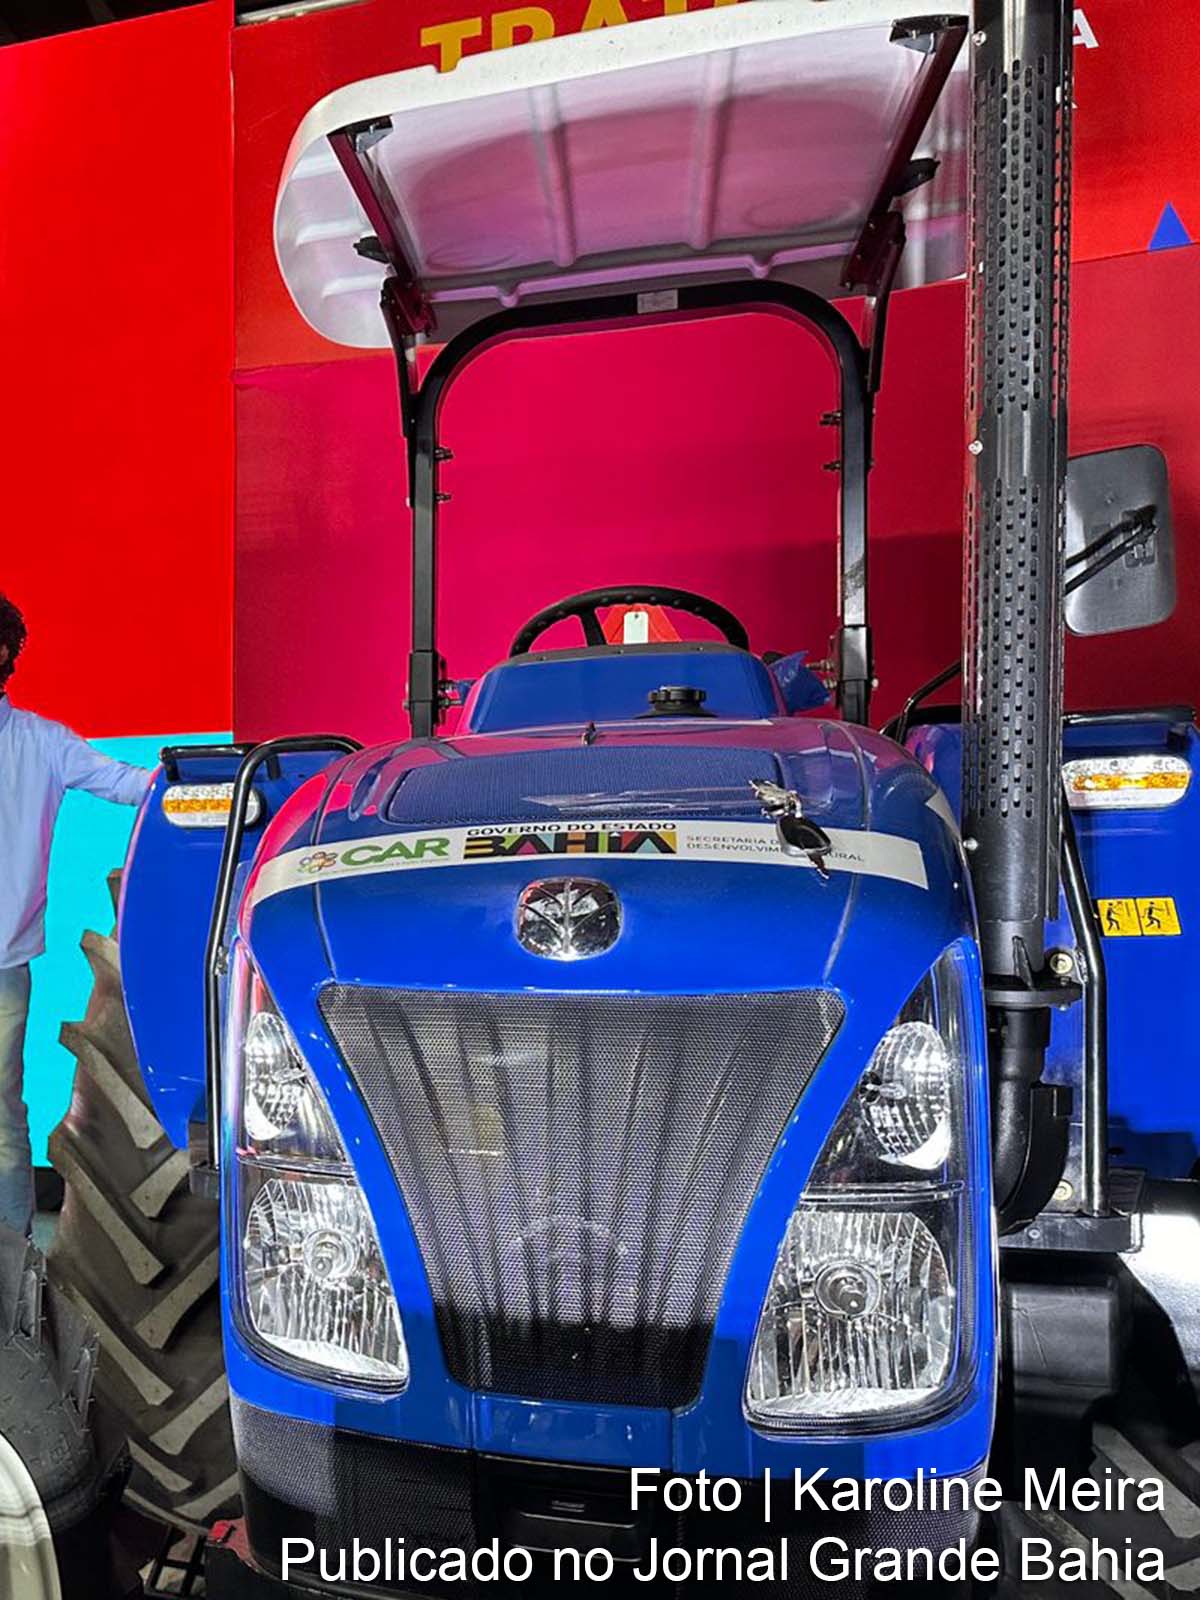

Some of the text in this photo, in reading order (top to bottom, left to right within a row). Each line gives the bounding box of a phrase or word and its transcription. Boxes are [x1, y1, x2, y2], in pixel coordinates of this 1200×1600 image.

[467, 821, 677, 837] GOVERNO DO ESTADO
[686, 834, 767, 845] SECRETARIA
[340, 836, 451, 867] CAR
[464, 830, 677, 860] BAHIA
